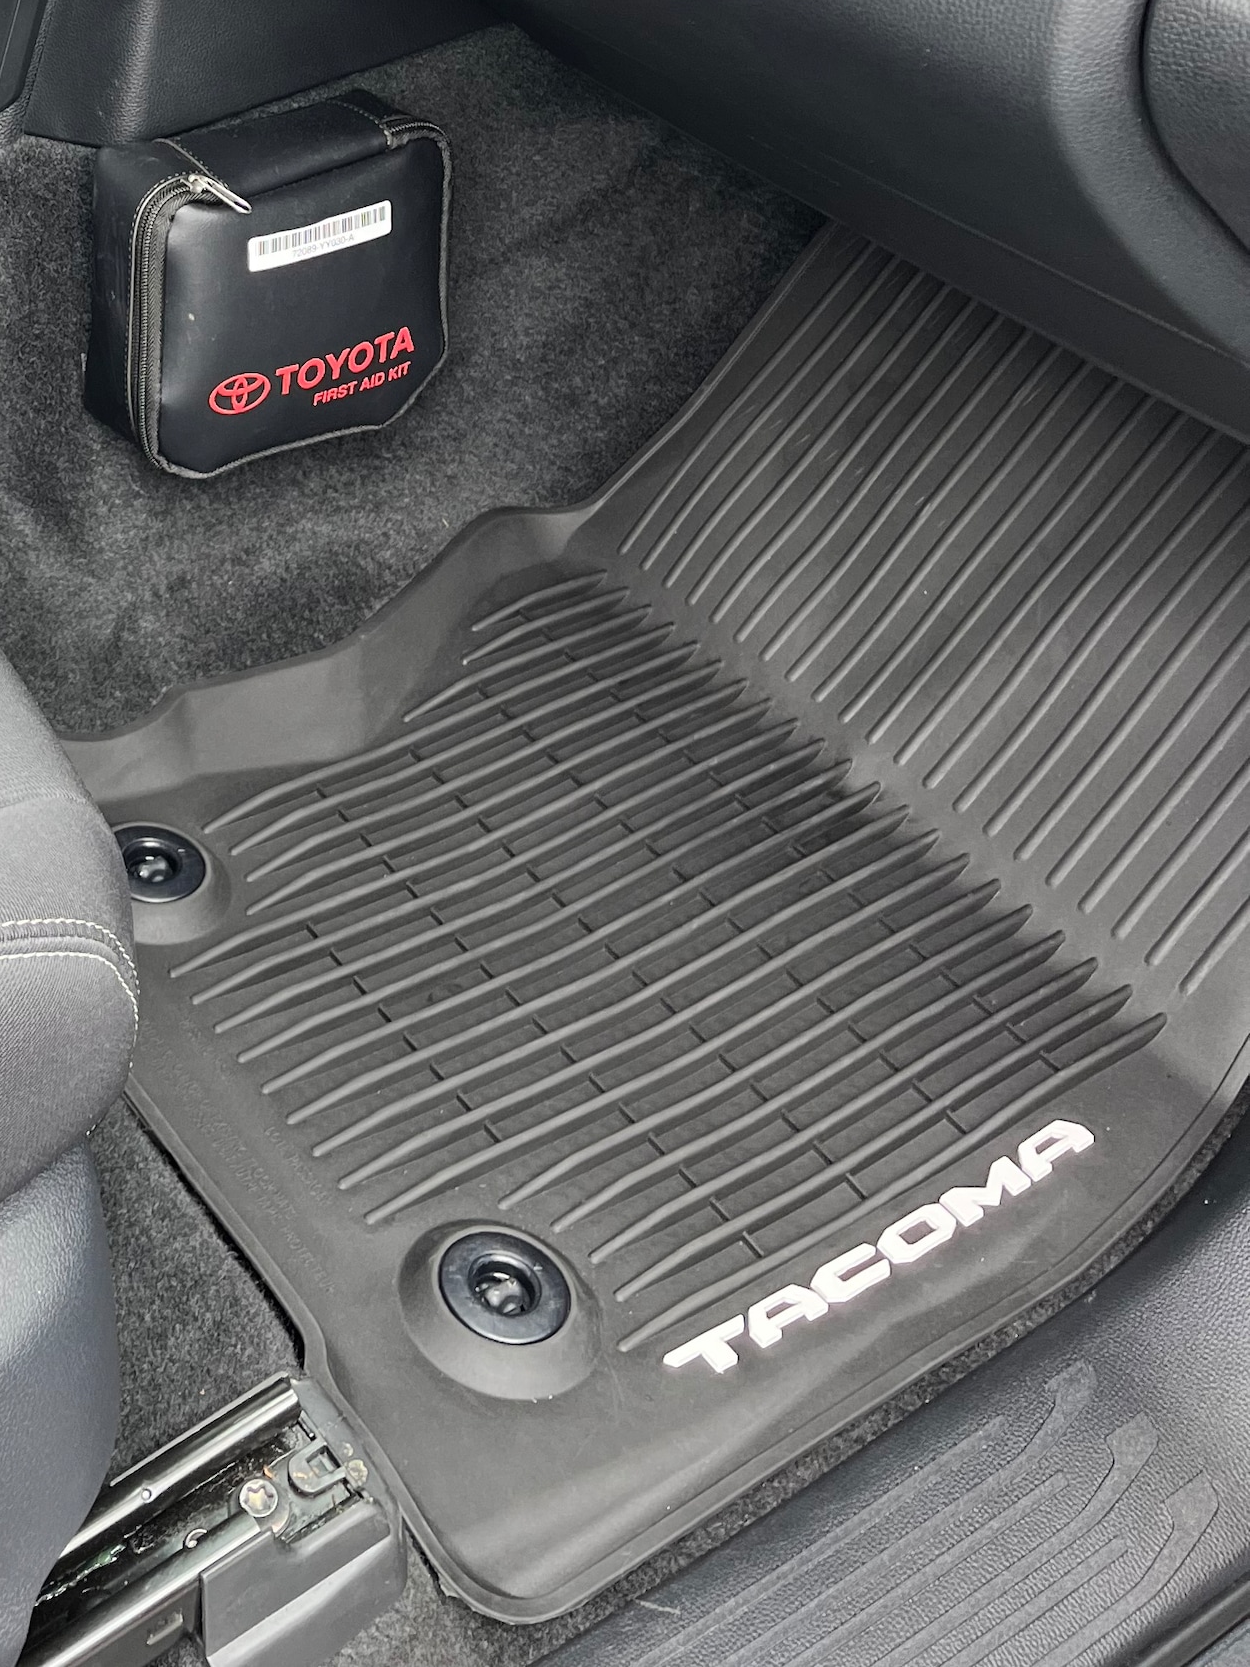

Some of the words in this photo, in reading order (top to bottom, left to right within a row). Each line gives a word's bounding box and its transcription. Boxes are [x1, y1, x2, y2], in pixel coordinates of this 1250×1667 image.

[275, 326, 415, 395] TOYOTA
[312, 383, 356, 407] FIRST
[358, 372, 386, 393] AID
[387, 361, 412, 383] KIT
[662, 1118, 1096, 1374] TACOMA
